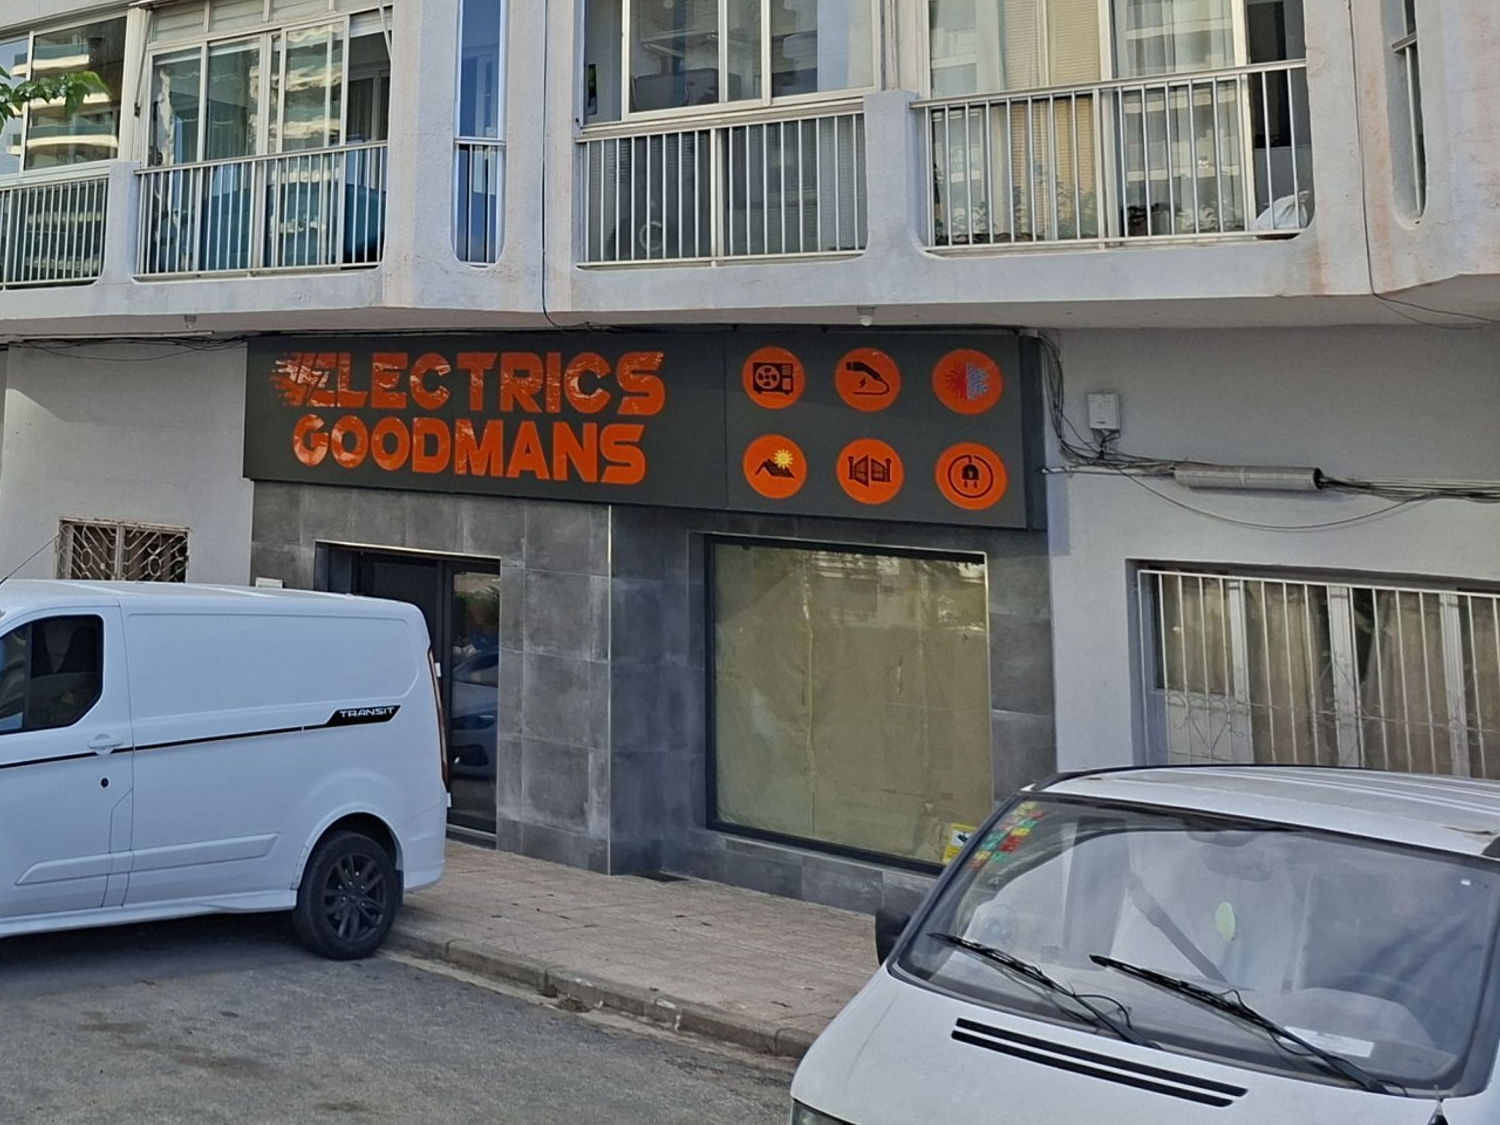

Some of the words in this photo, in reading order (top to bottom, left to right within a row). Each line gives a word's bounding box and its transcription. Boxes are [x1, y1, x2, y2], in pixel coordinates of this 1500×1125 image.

[270, 351, 667, 416] ELECTRICS
[292, 412, 648, 486] GOODMANS
[340, 707, 395, 718] TRANSIT
